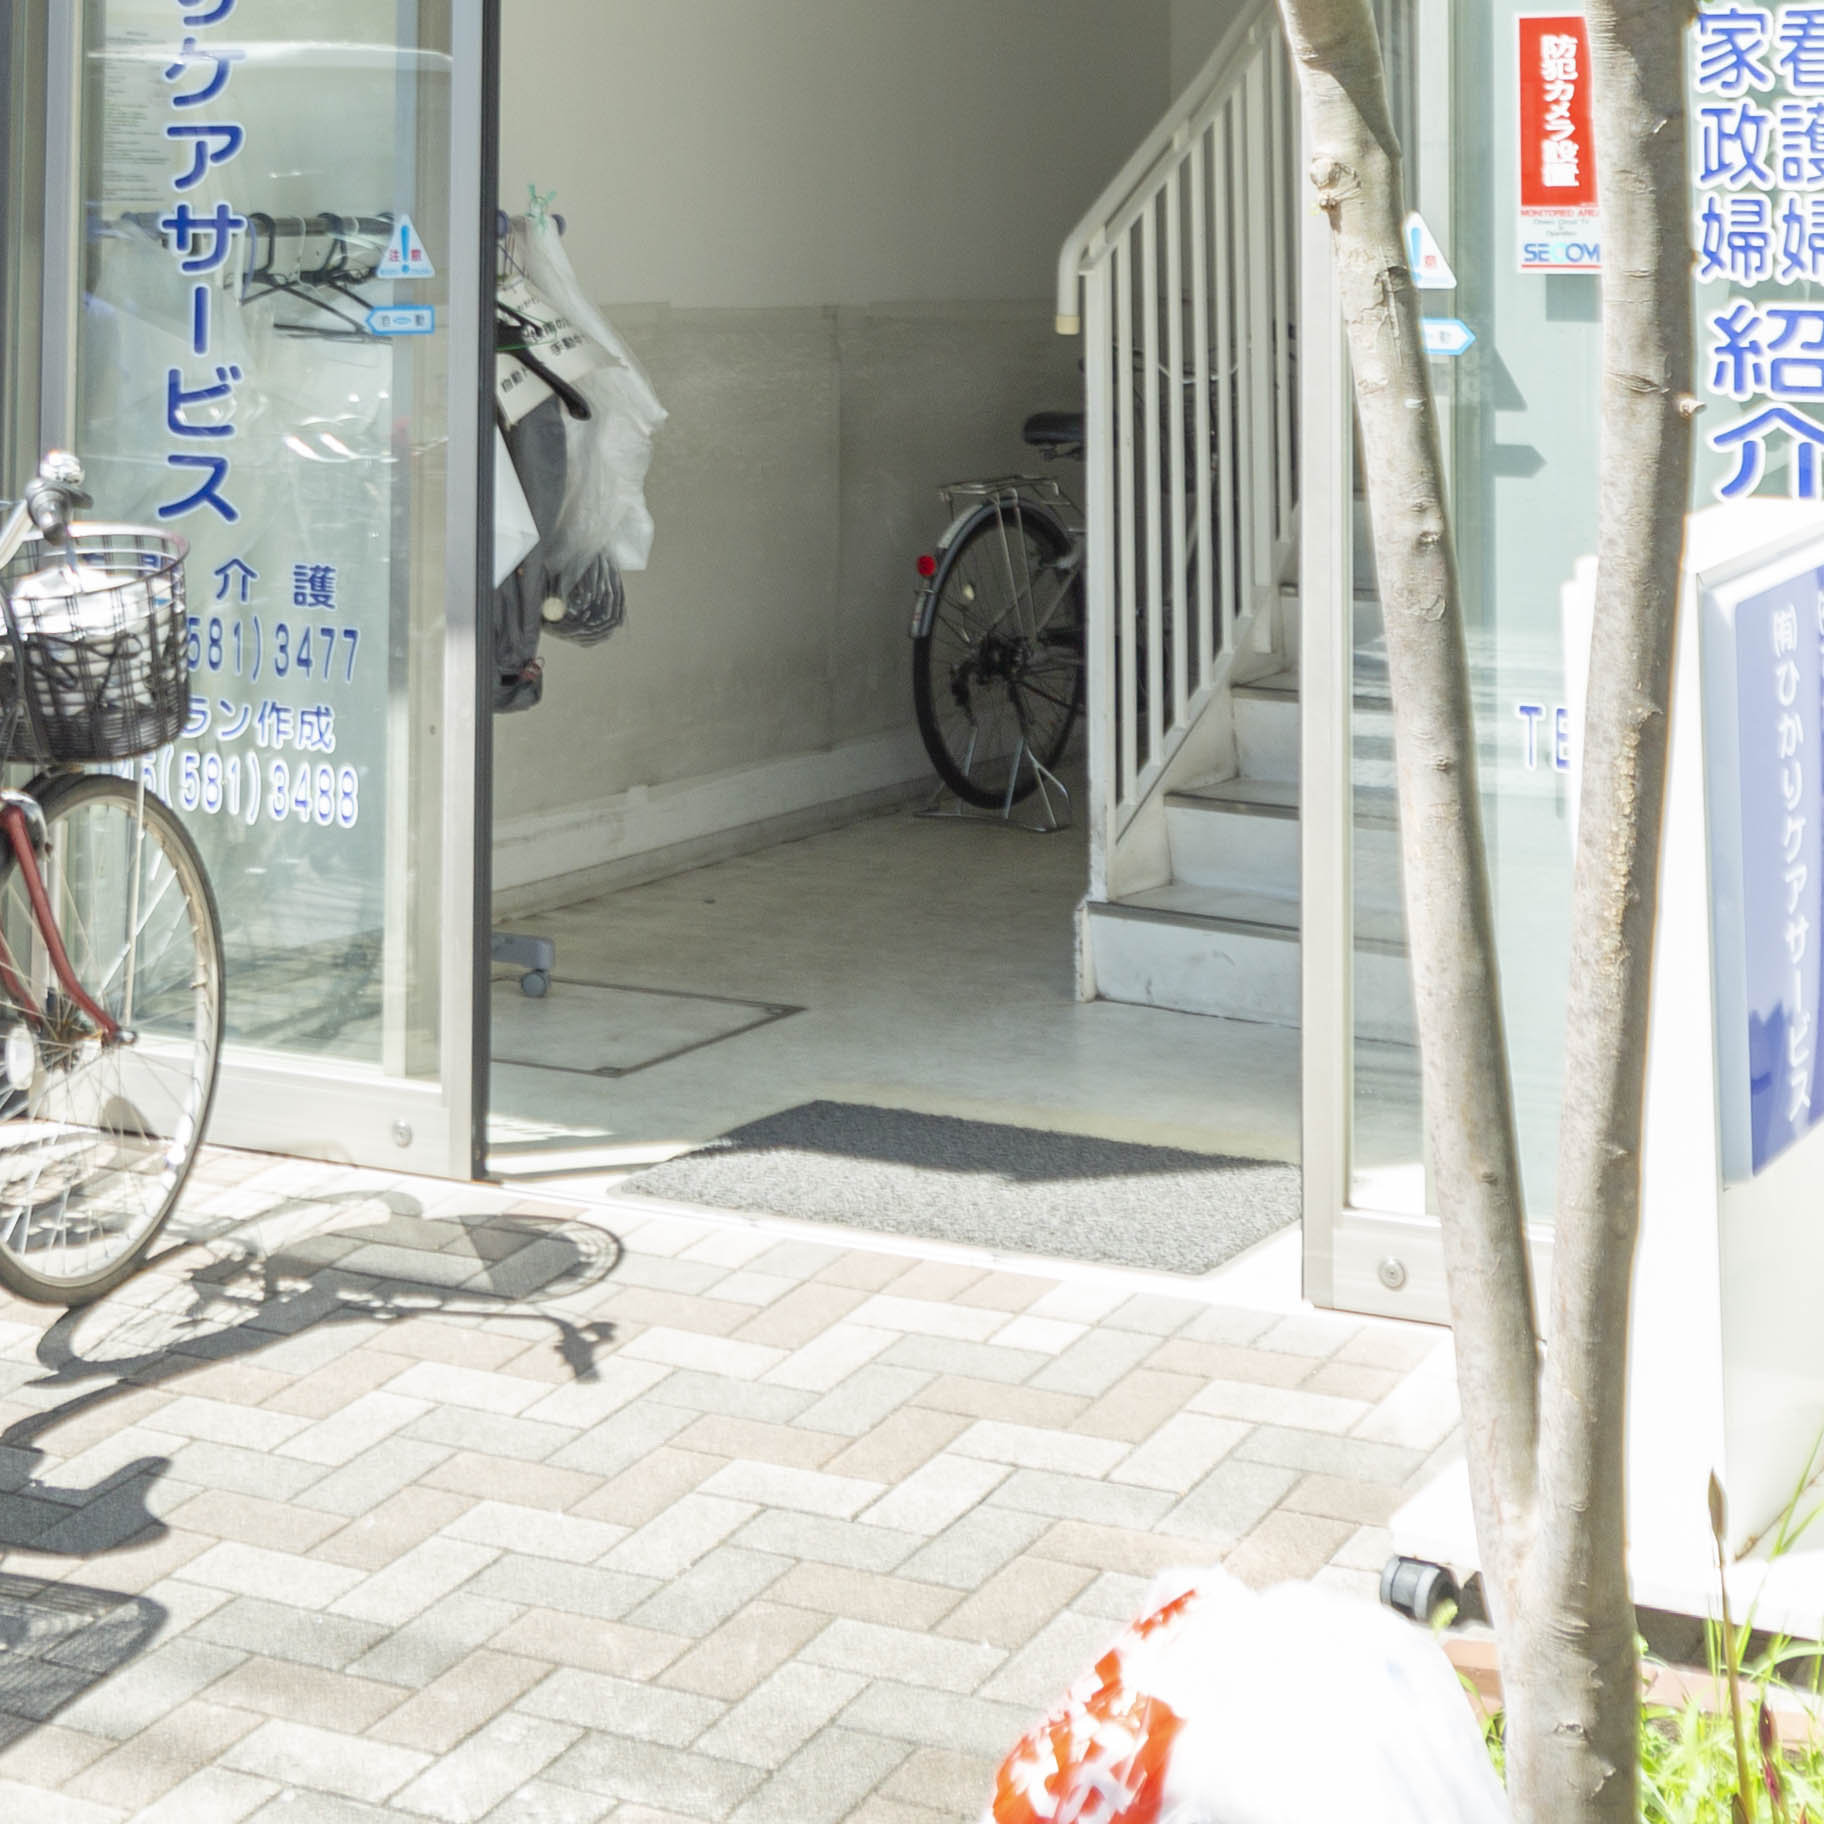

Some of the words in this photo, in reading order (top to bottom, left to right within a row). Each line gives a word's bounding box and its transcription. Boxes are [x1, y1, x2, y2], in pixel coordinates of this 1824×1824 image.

[1695, 4, 1774, 284] 家政婦
[1524, 242, 1601, 263] SECOM
